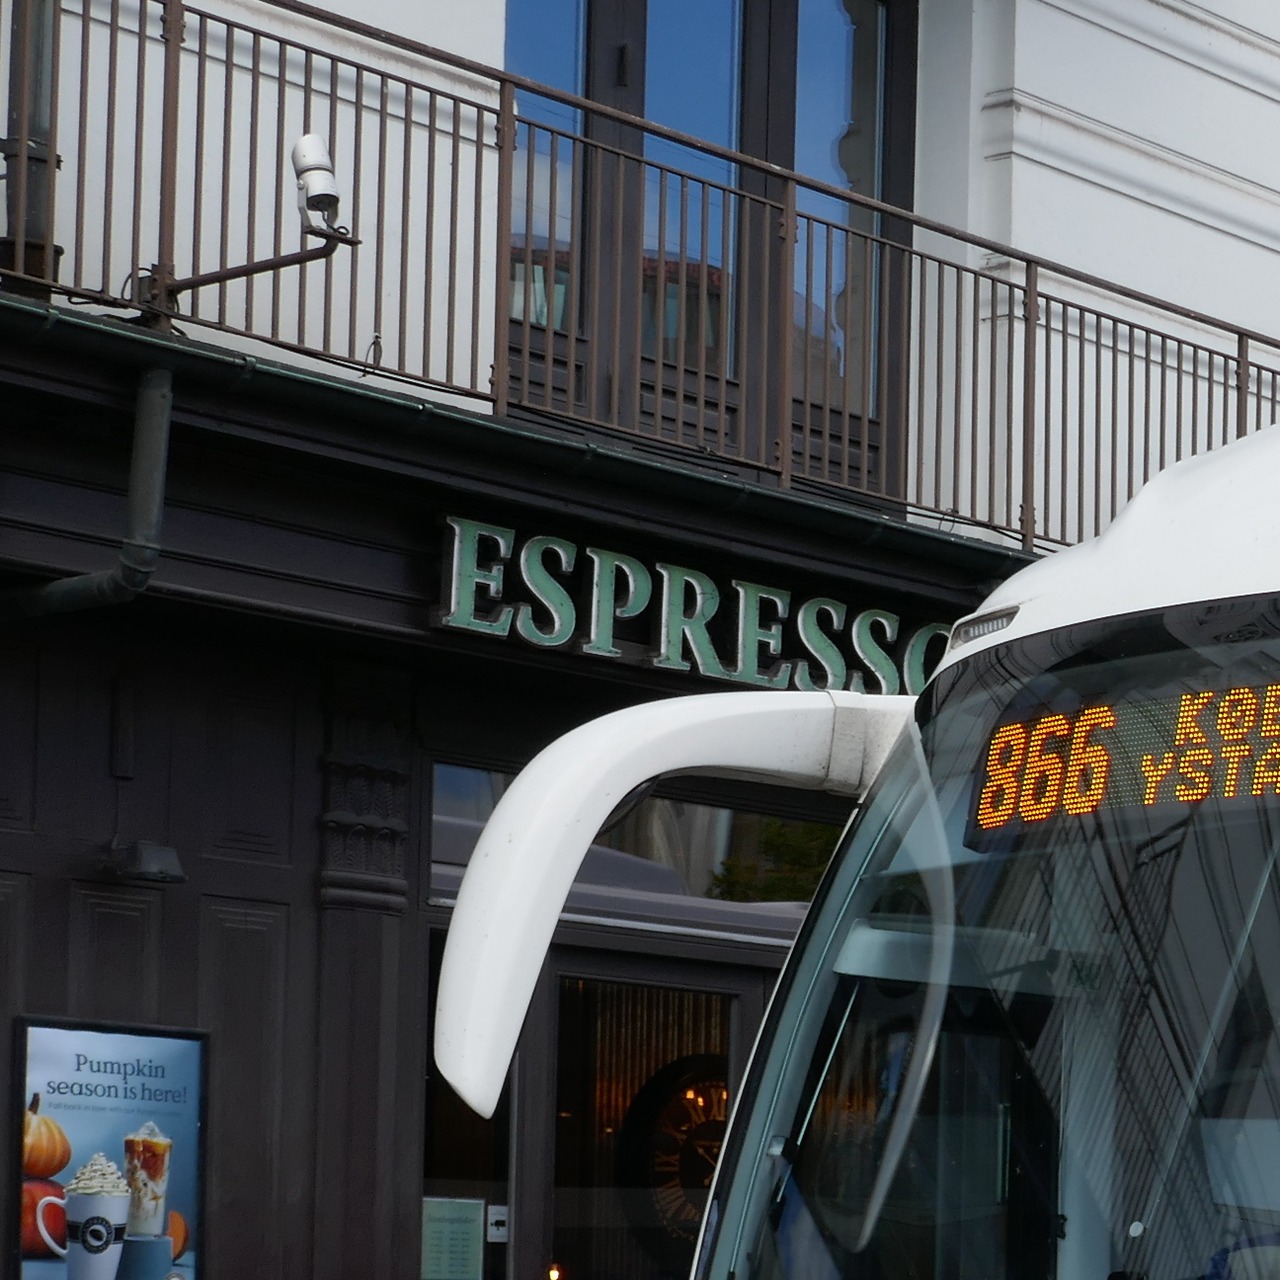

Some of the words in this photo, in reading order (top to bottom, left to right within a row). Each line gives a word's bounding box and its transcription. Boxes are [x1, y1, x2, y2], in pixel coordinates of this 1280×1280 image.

[977, 705, 1116, 829] 866
[74, 1053, 166, 1081] Pumpkin
[46, 1080, 119, 1098] season
[122, 1081, 137, 1100] is
[141, 1082, 188, 1104] here!
